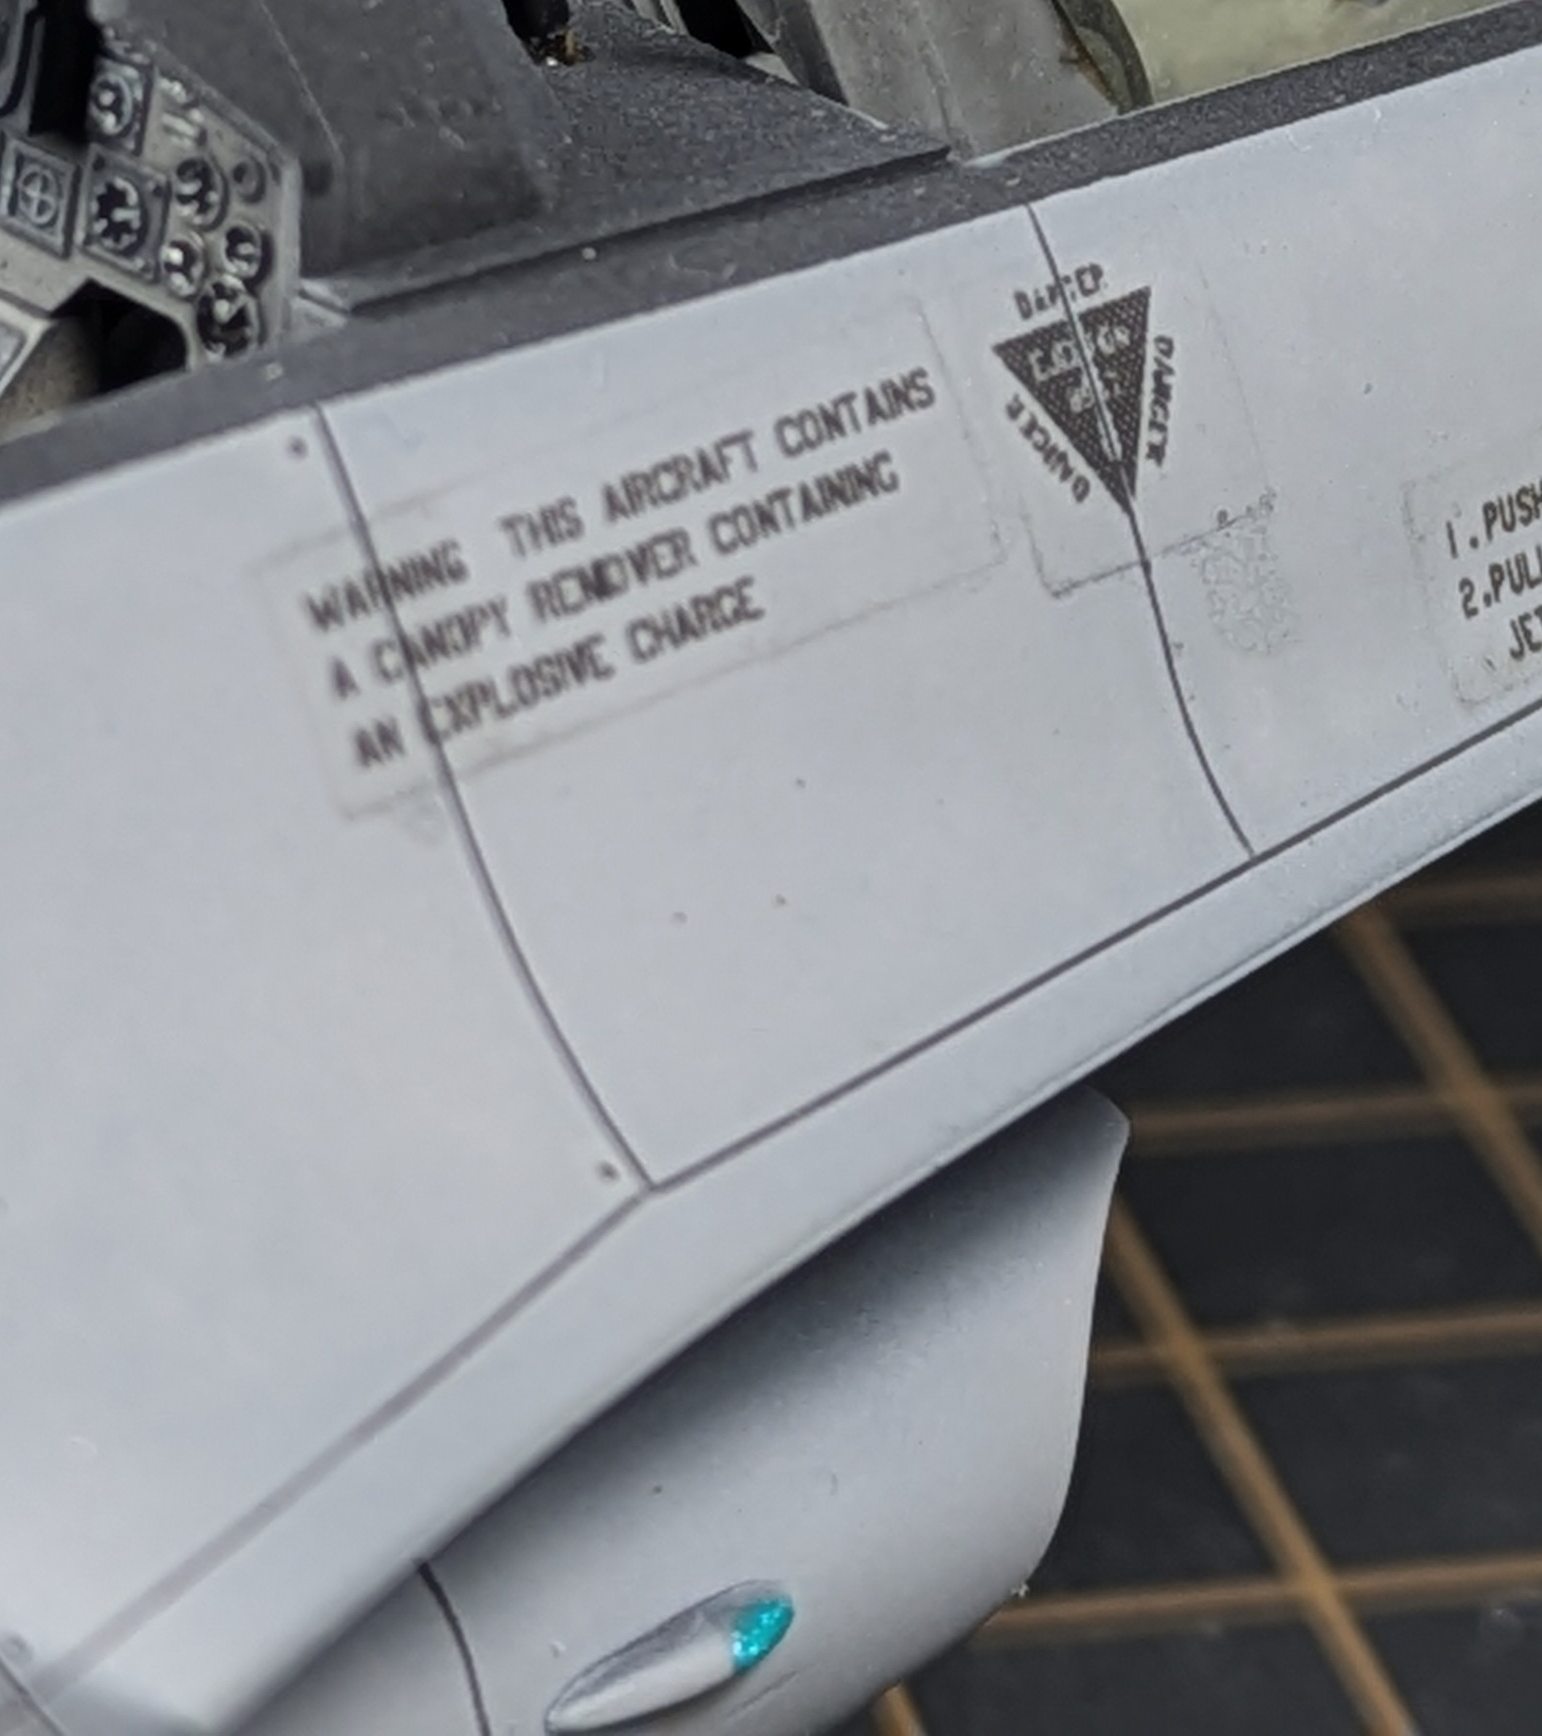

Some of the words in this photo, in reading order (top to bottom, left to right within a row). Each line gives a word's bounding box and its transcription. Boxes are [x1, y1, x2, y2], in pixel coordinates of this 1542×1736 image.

[305, 539, 469, 633] WARNING
[500, 496, 584, 560] THIS
[602, 429, 760, 524] AIRCRAFT
[773, 367, 937, 459] CONTAINS
[330, 657, 360, 701] A
[369, 595, 510, 684] CANOPY
[707, 450, 900, 556] CONTAINING
[353, 716, 404, 769] AN
[419, 633, 616, 746] EXPLOSIVE
[624, 576, 766, 664] CHARGE
